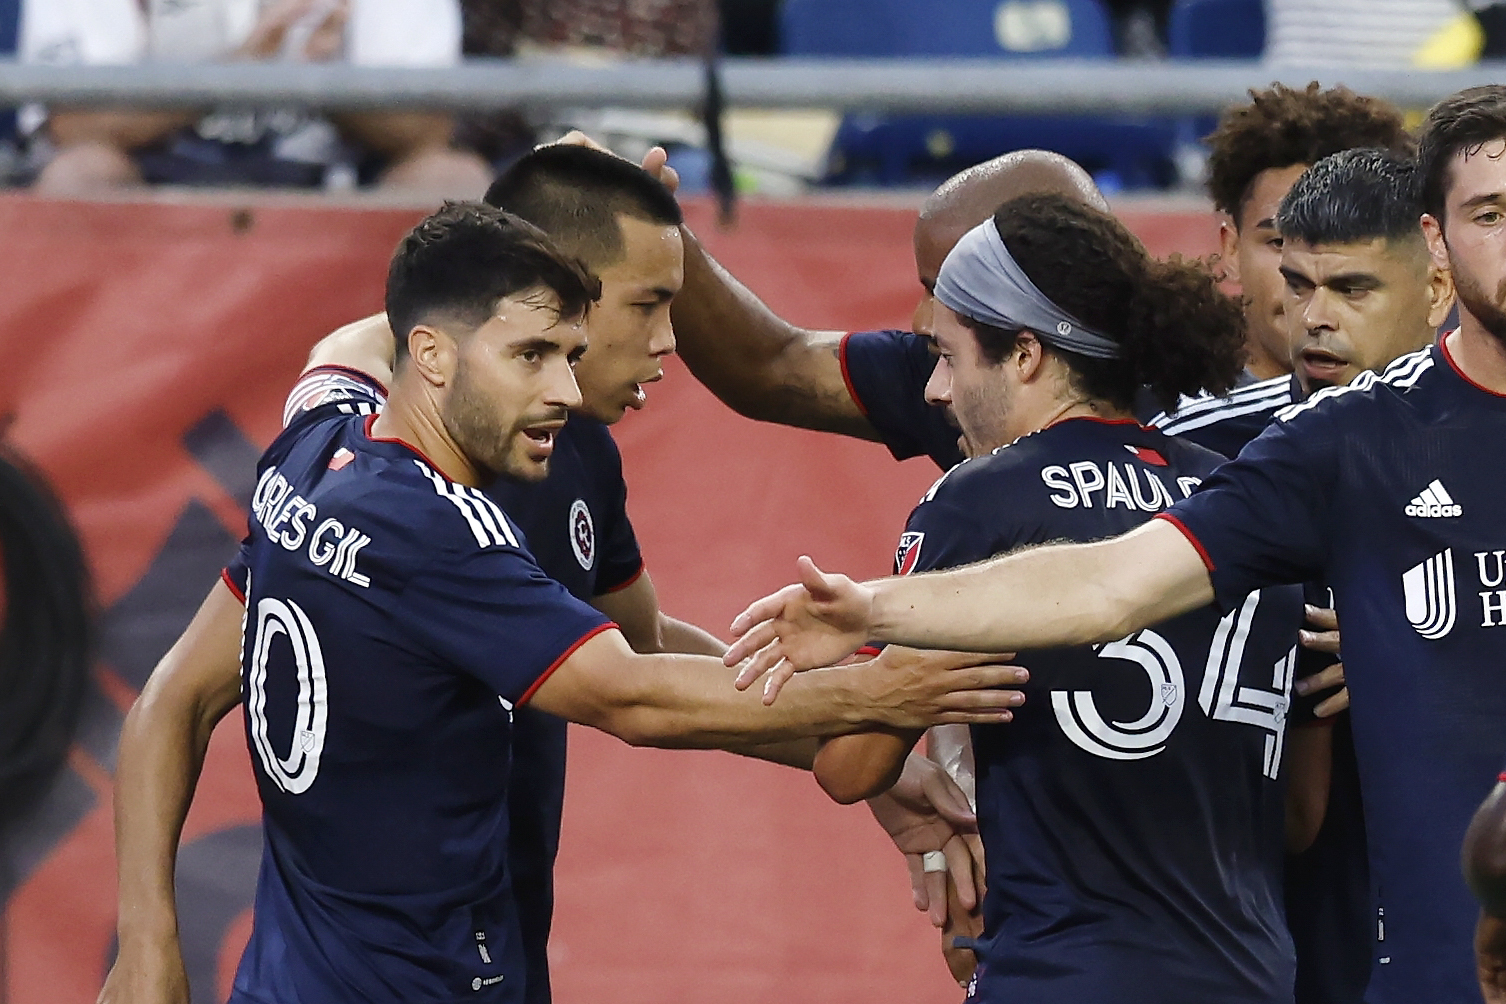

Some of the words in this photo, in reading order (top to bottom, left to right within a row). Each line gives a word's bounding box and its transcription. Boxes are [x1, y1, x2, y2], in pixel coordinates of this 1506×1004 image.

[1404, 503, 1463, 518] adidas
[308, 517, 372, 588] GIL
[1050, 588, 1297, 780] 34
